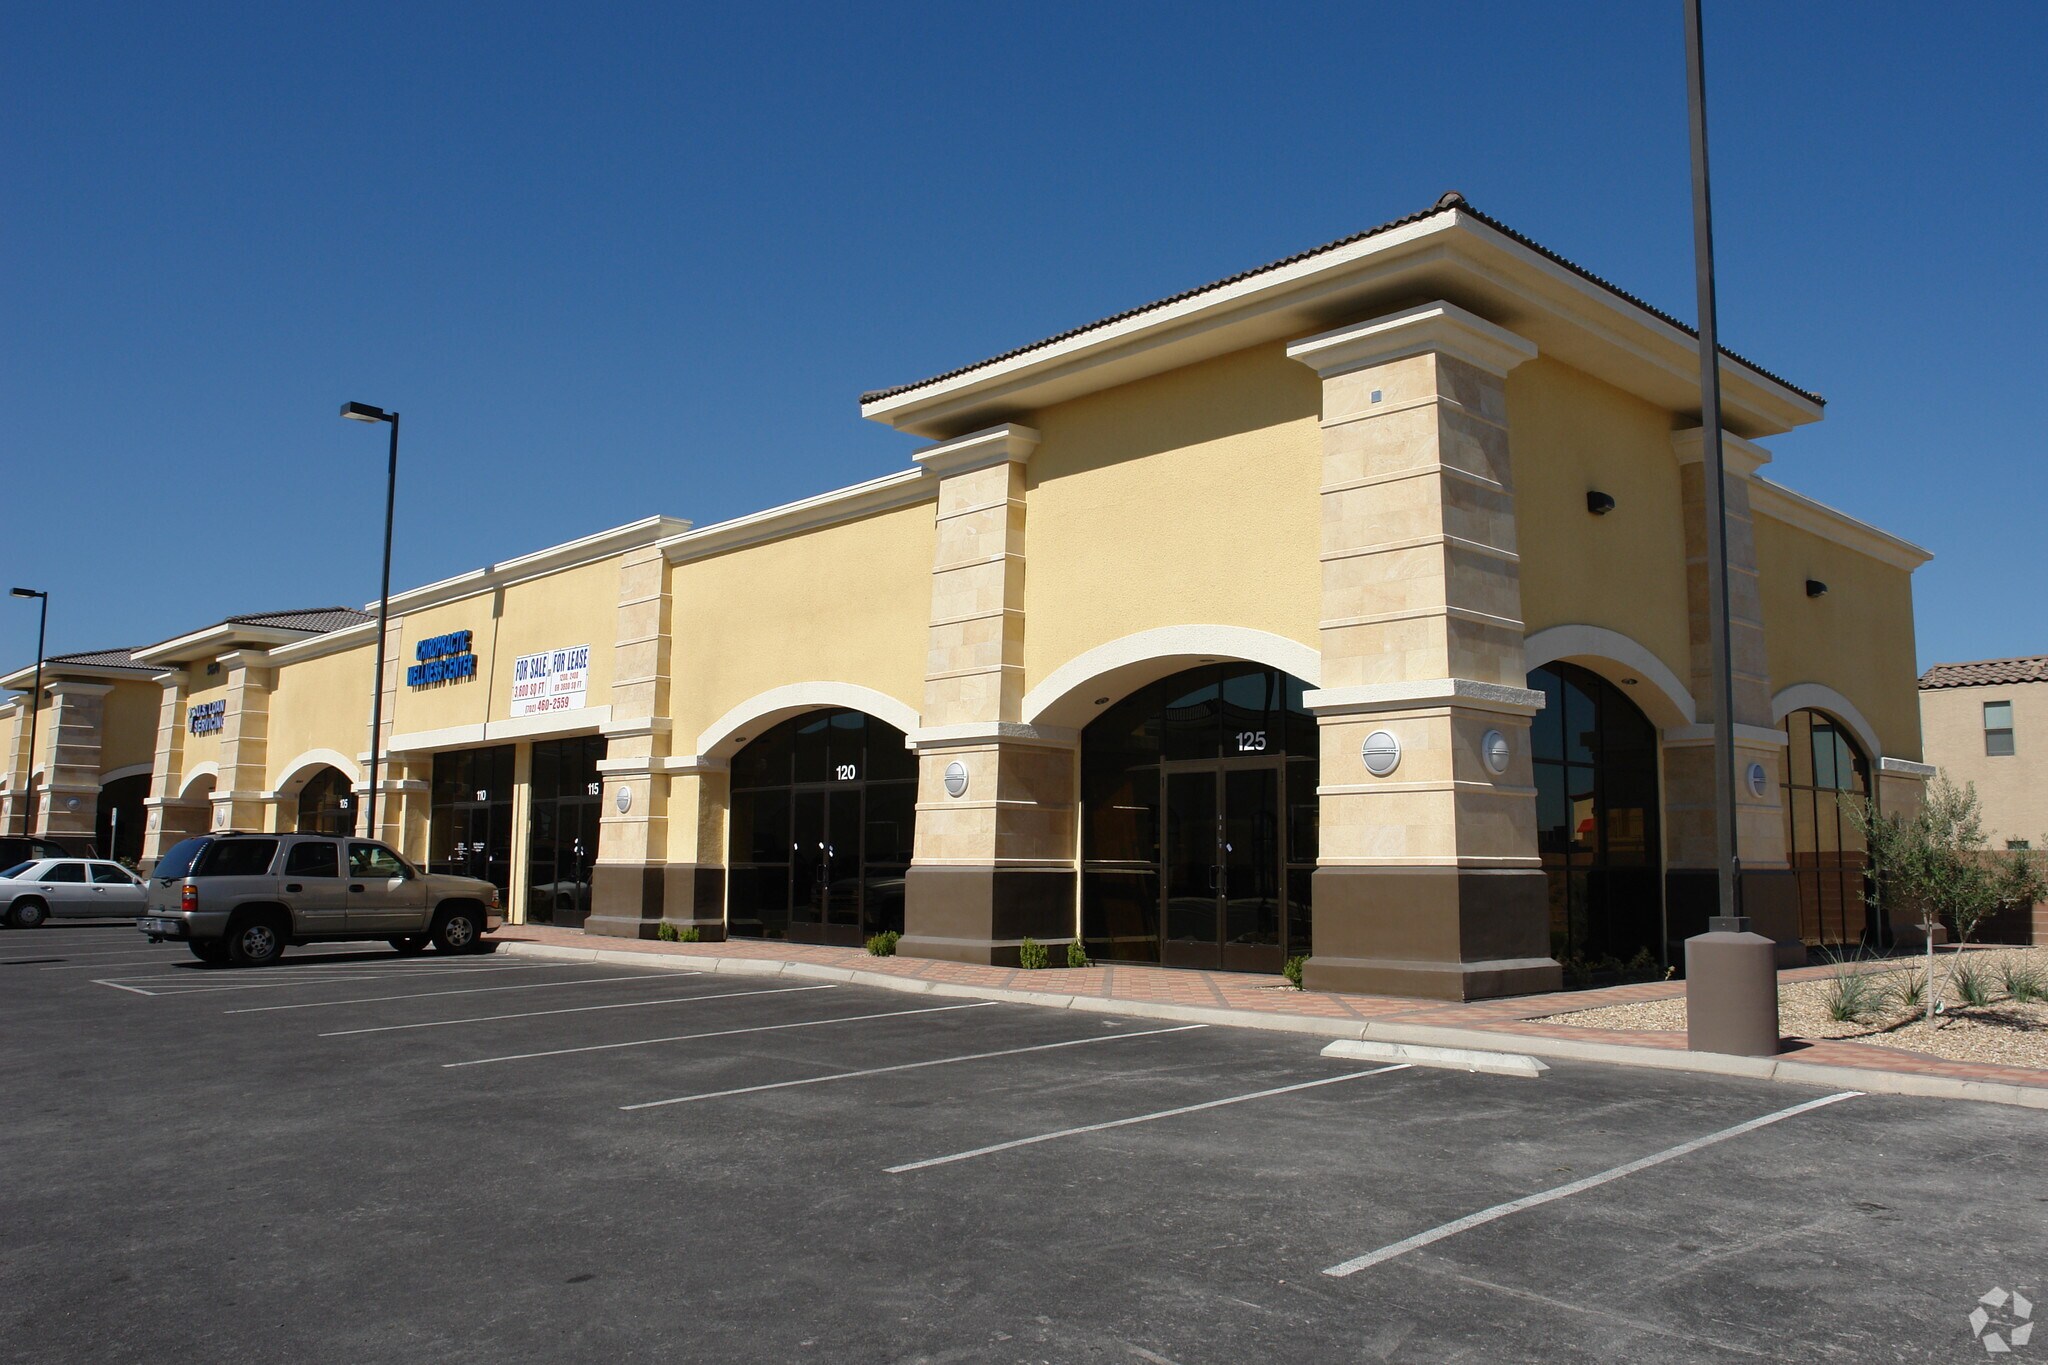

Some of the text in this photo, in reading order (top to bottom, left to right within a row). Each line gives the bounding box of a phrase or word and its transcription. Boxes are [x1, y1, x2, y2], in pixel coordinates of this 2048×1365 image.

[416, 629, 470, 661] CHIROPRACTIC
[515, 660, 528, 681] FOR
[530, 656, 547, 679] SALE
[553, 653, 566, 673] FOR
[567, 648, 588, 671] LEASE
[407, 654, 474, 686] WELLNESS CENTER
[538, 682, 545, 694] FT
[208, 699, 225, 715] LOAN
[537, 696, 570, 711] 460-2559
[1235, 731, 1267, 751] 125
[836, 764, 856, 780] 120
[476, 789, 487, 801] 110
[587, 782, 599, 795] 115
